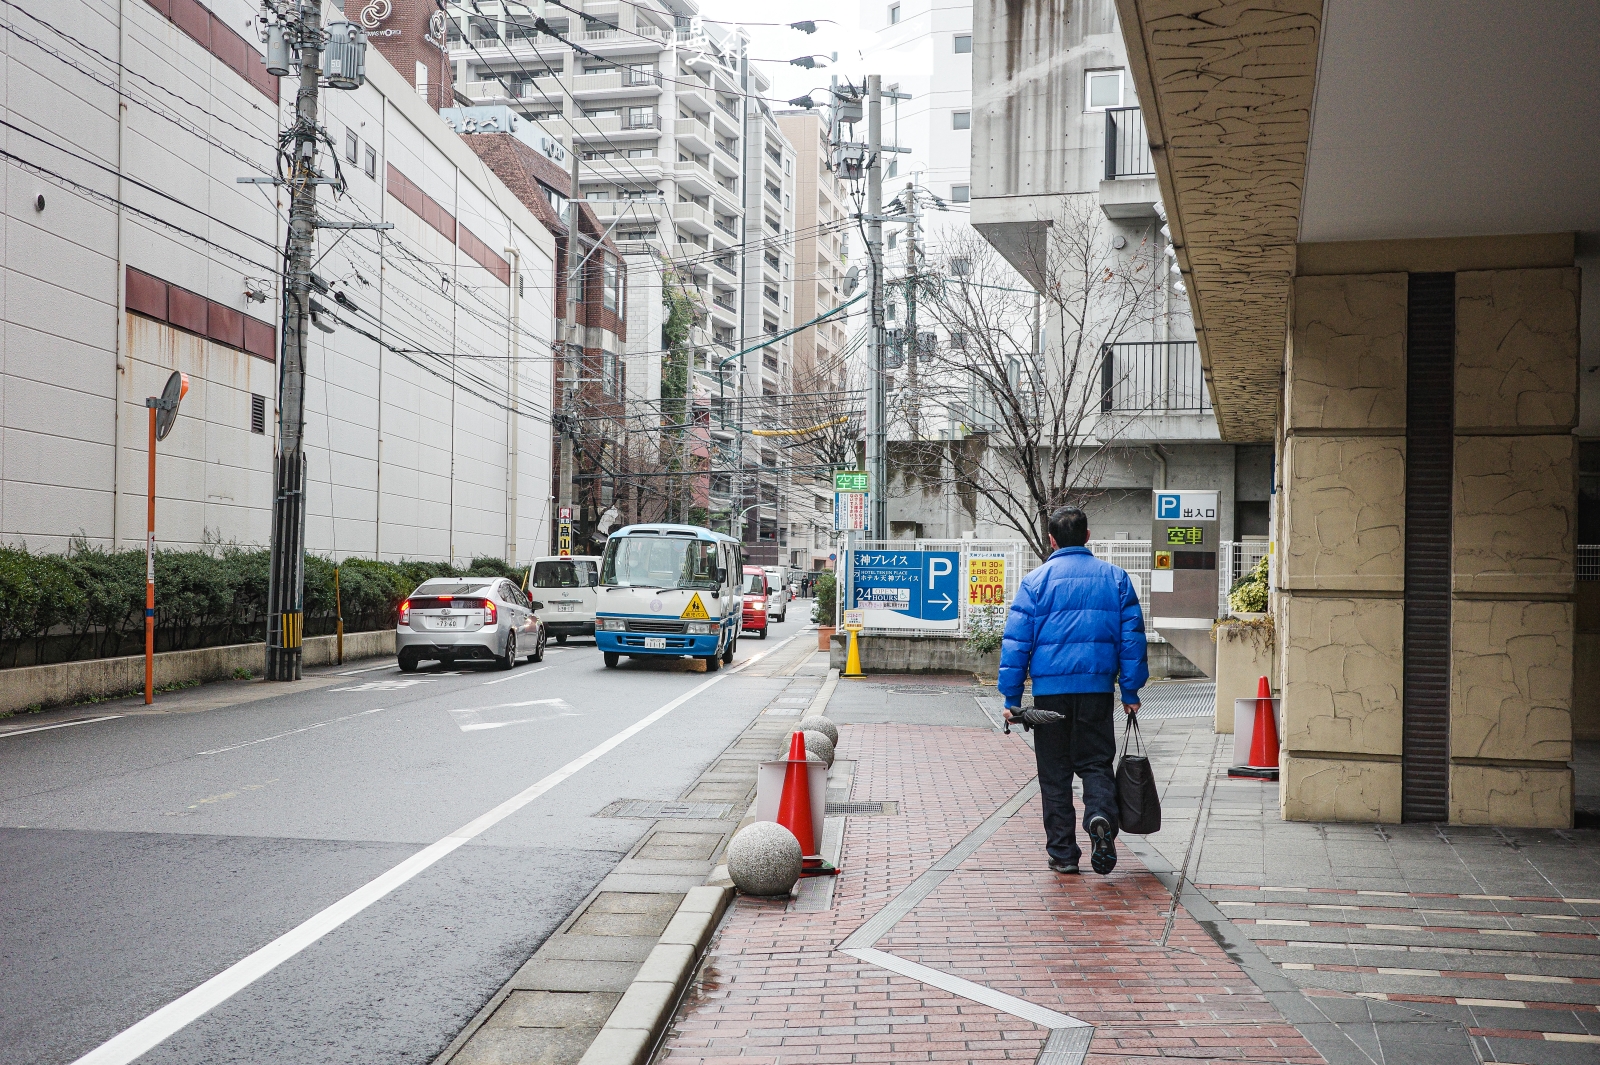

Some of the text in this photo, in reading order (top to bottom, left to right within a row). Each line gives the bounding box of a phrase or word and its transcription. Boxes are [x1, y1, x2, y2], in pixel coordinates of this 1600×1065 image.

[836, 473, 868, 490] 空車
[1161, 497, 1177, 516] P
[1183, 508, 1215, 518] 出入口
[1167, 526, 1203, 545] 空車
[928, 557, 953, 590] P
[856, 587, 872, 601] 24
